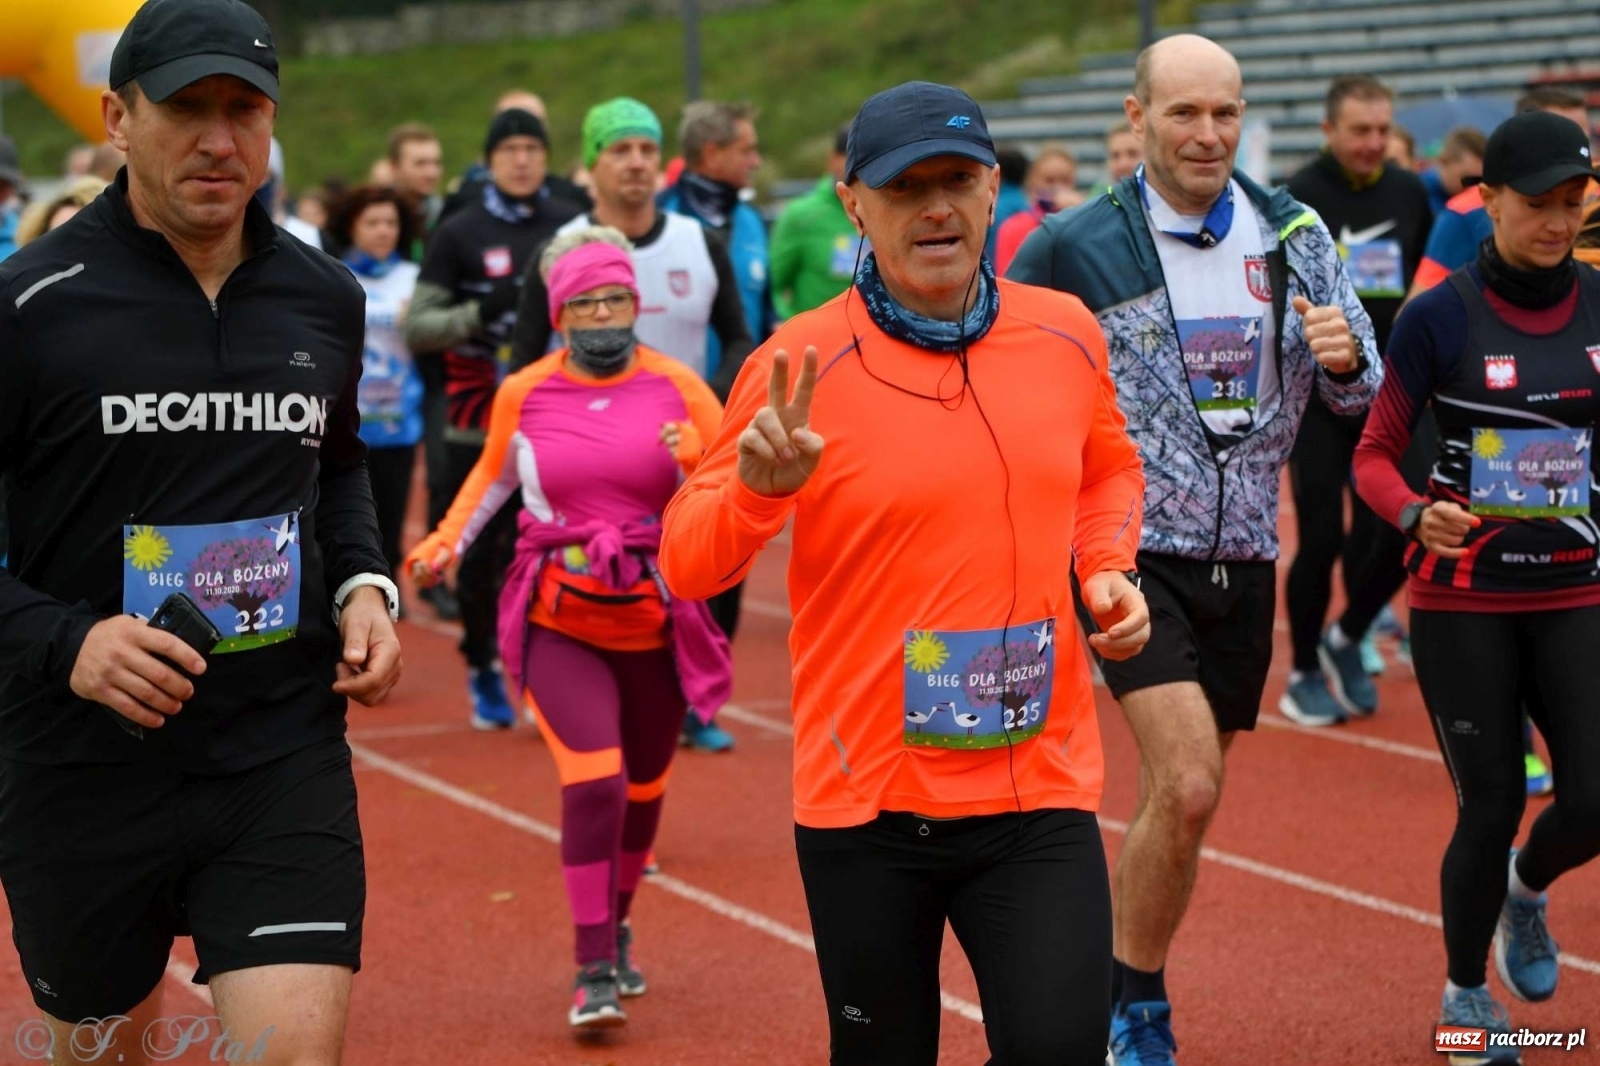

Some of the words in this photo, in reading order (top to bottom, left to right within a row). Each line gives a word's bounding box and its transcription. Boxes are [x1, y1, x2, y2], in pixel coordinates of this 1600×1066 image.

[946, 115, 971, 129] 4F
[1183, 352, 1204, 363] DLA
[1211, 380, 1247, 400] 238
[101, 392, 327, 436] DECATHLON
[1488, 460, 1512, 471] BIEG
[1518, 461, 1538, 471] DLA
[1547, 487, 1578, 508] 171
[148, 571, 184, 588] BIEG
[194, 571, 223, 587] DLA
[233, 561, 289, 583] BOŻENY
[206, 585, 240, 595] 11.10.2020
[235, 604, 284, 633] 222
[927, 674, 960, 687] BIEG
[969, 672, 996, 687] DLA
[1004, 662, 1047, 684] BOŻENY
[1003, 701, 1041, 729] 225
